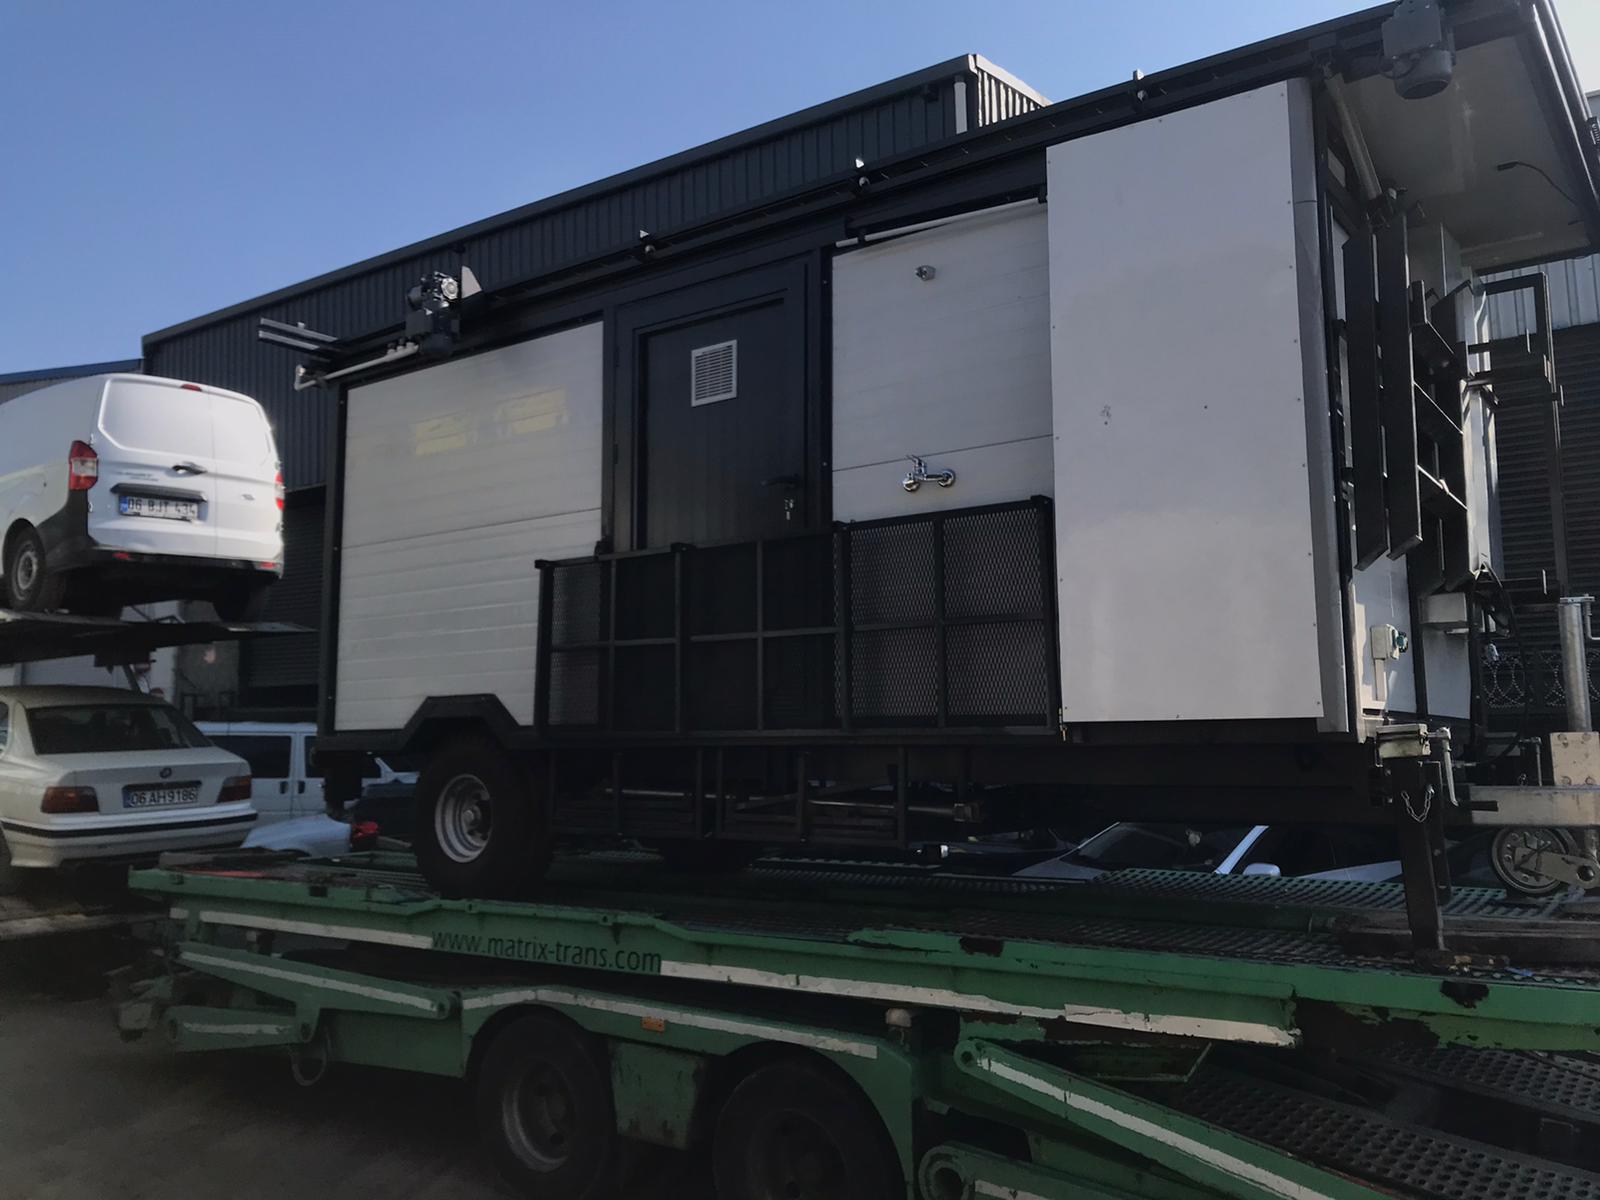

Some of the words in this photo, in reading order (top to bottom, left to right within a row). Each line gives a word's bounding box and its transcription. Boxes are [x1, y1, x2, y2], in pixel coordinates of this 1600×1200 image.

[128, 498, 142, 511] 06
[131, 792, 147, 806] 06
[431, 930, 662, 974] www.matrix-trans.com
